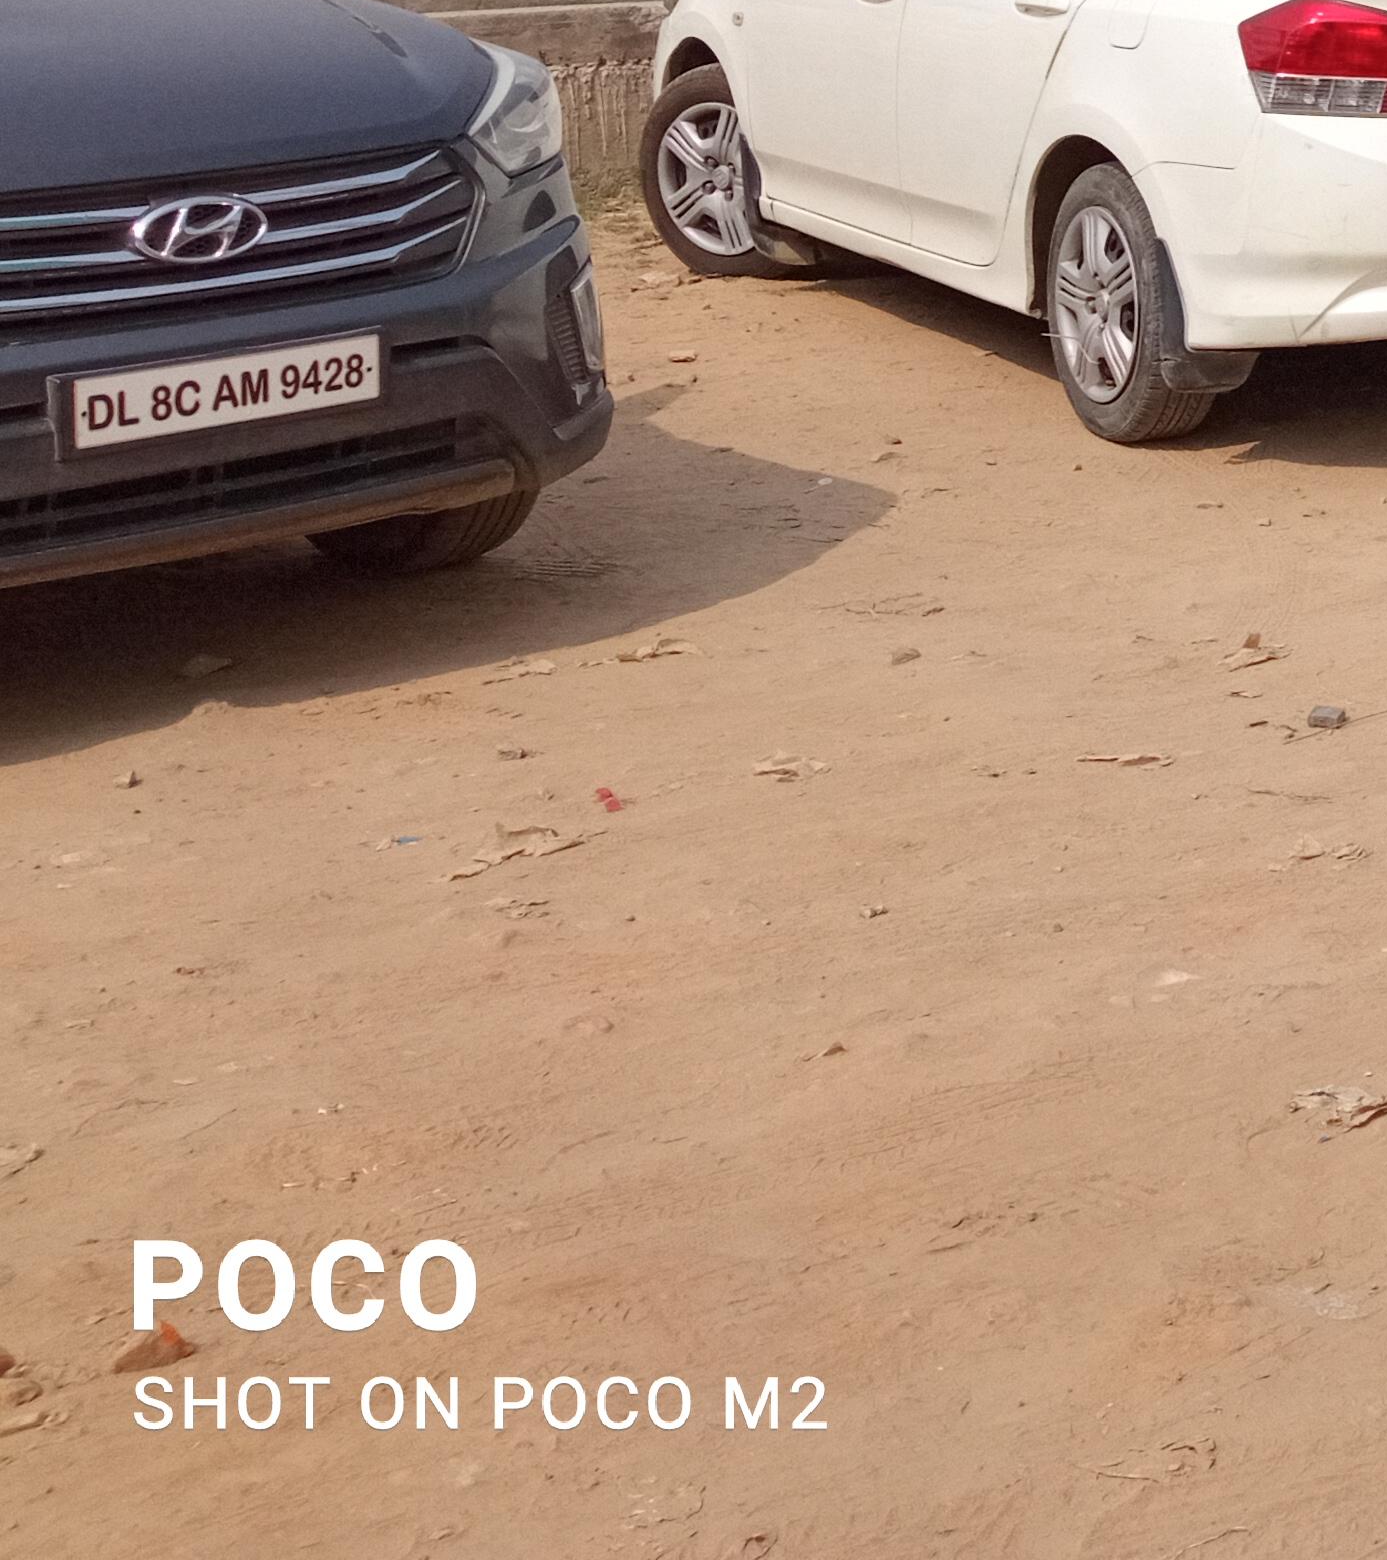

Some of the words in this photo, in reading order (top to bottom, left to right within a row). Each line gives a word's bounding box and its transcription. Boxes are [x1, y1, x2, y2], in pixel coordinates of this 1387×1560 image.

[87, 390, 140, 431] DL
[151, 379, 201, 422] 8C
[211, 367, 269, 412] AM
[280, 353, 364, 400] 9428
